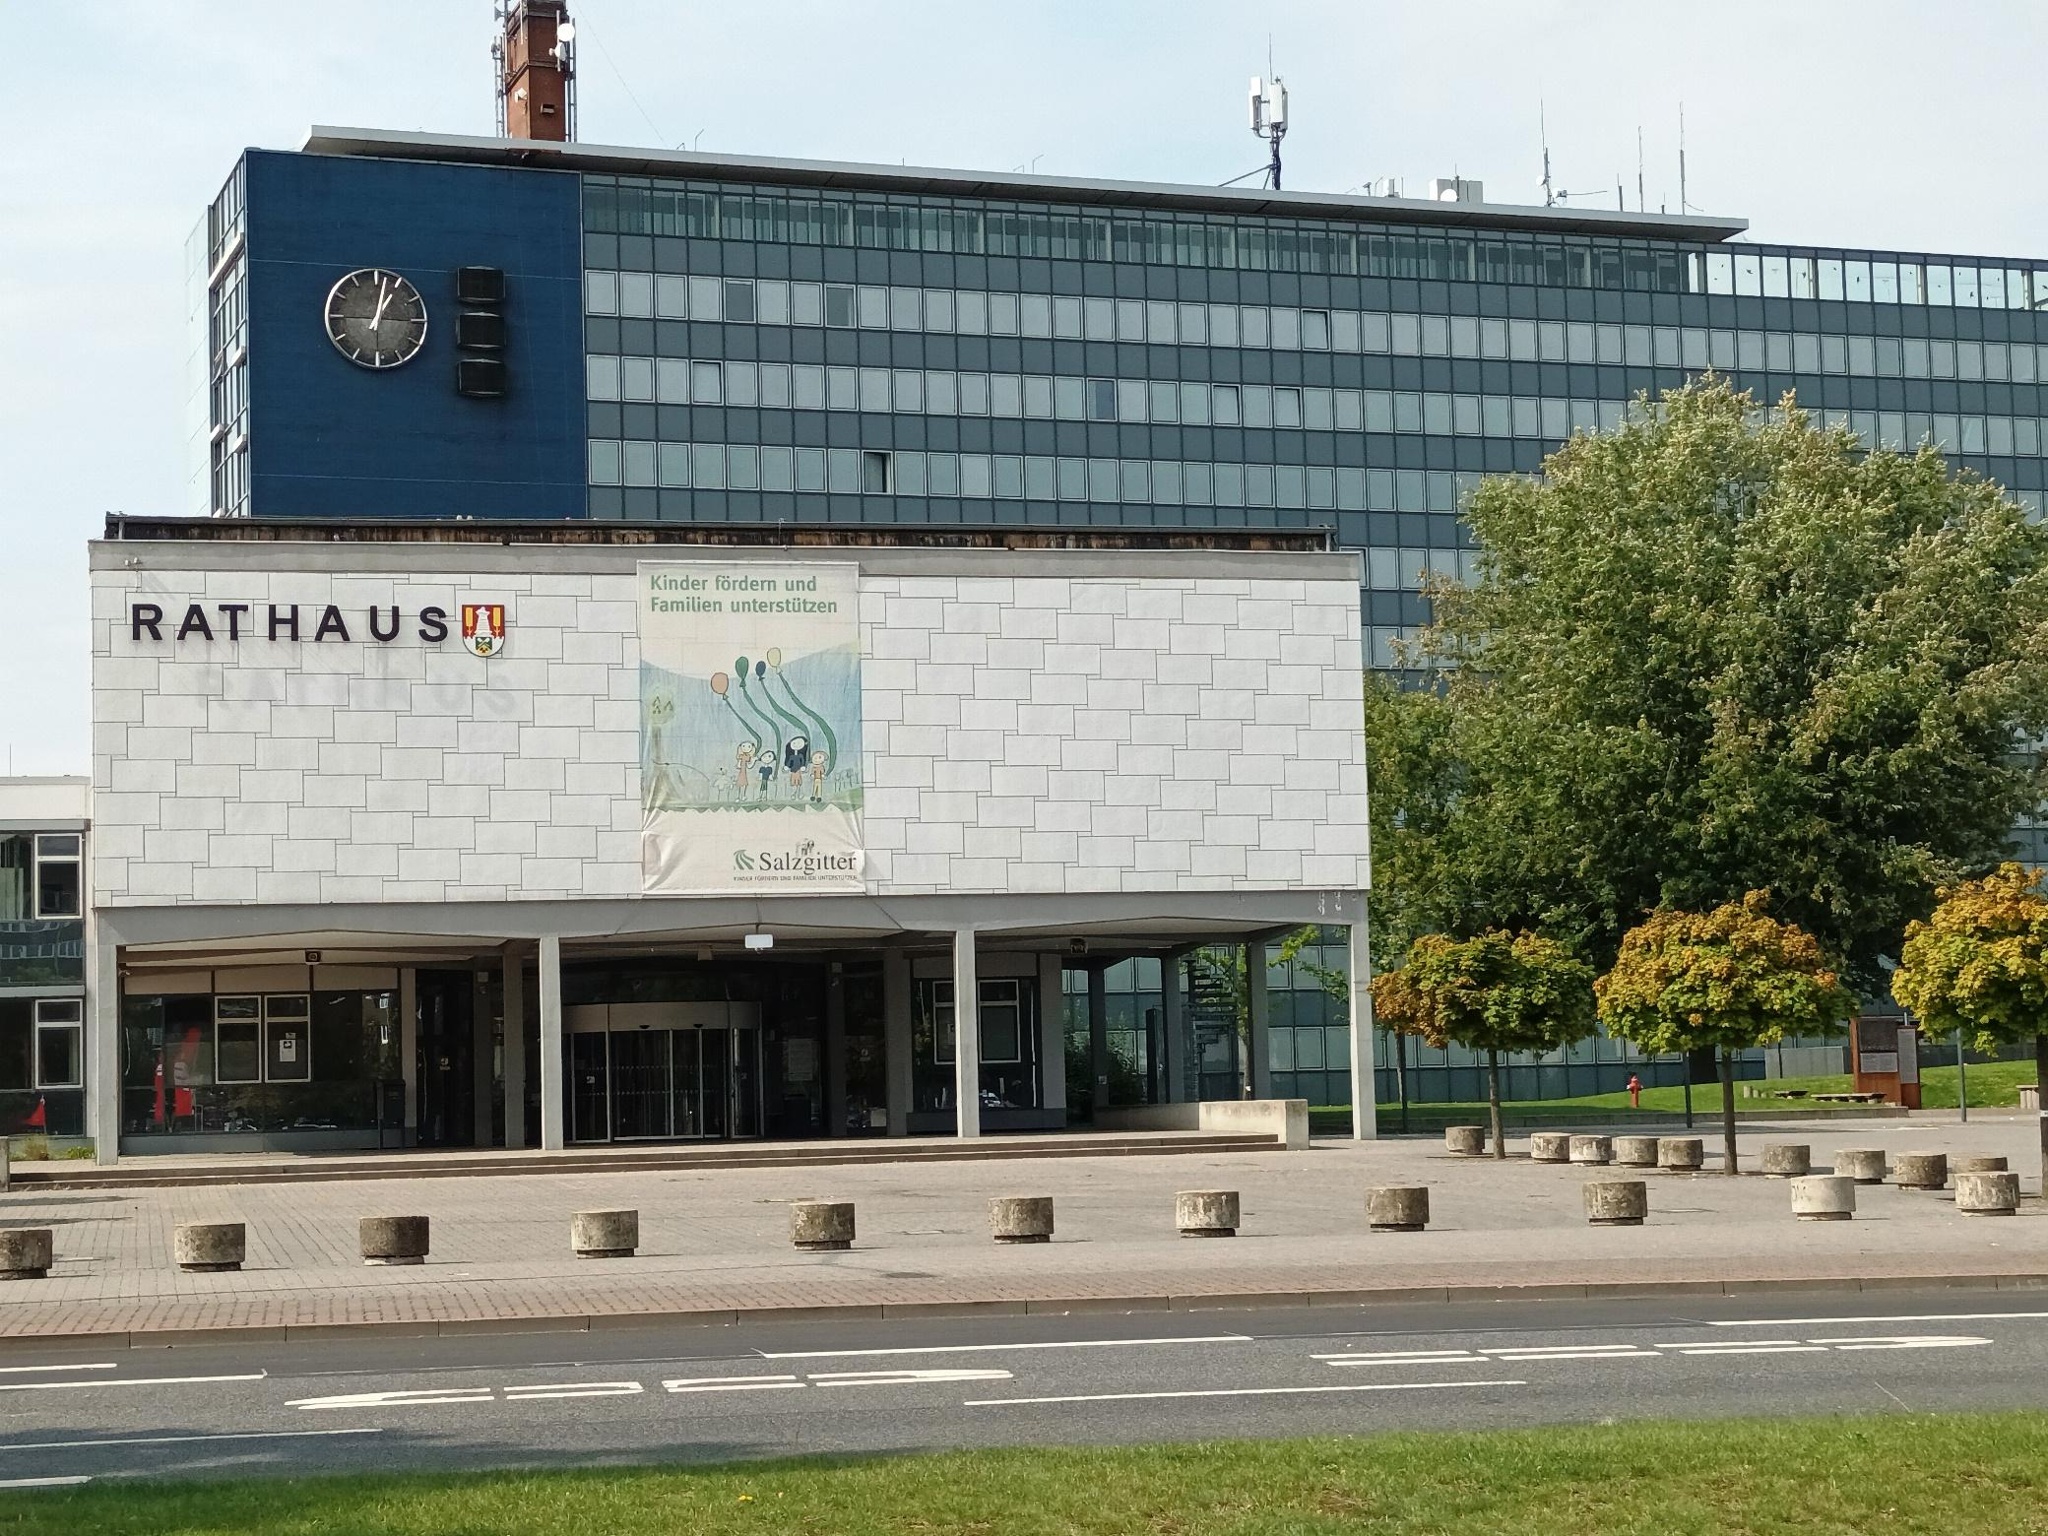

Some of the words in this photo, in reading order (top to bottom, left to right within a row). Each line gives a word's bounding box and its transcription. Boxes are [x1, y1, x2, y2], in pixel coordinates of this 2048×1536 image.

[650, 575, 708, 592] Kinder
[715, 575, 777, 592] fördern
[785, 576, 817, 592] und
[651, 597, 723, 613] Familien
[730, 598, 838, 613] unterstützen
[132, 603, 449, 643] RATHAUS
[759, 852, 857, 876] Salzgitter
